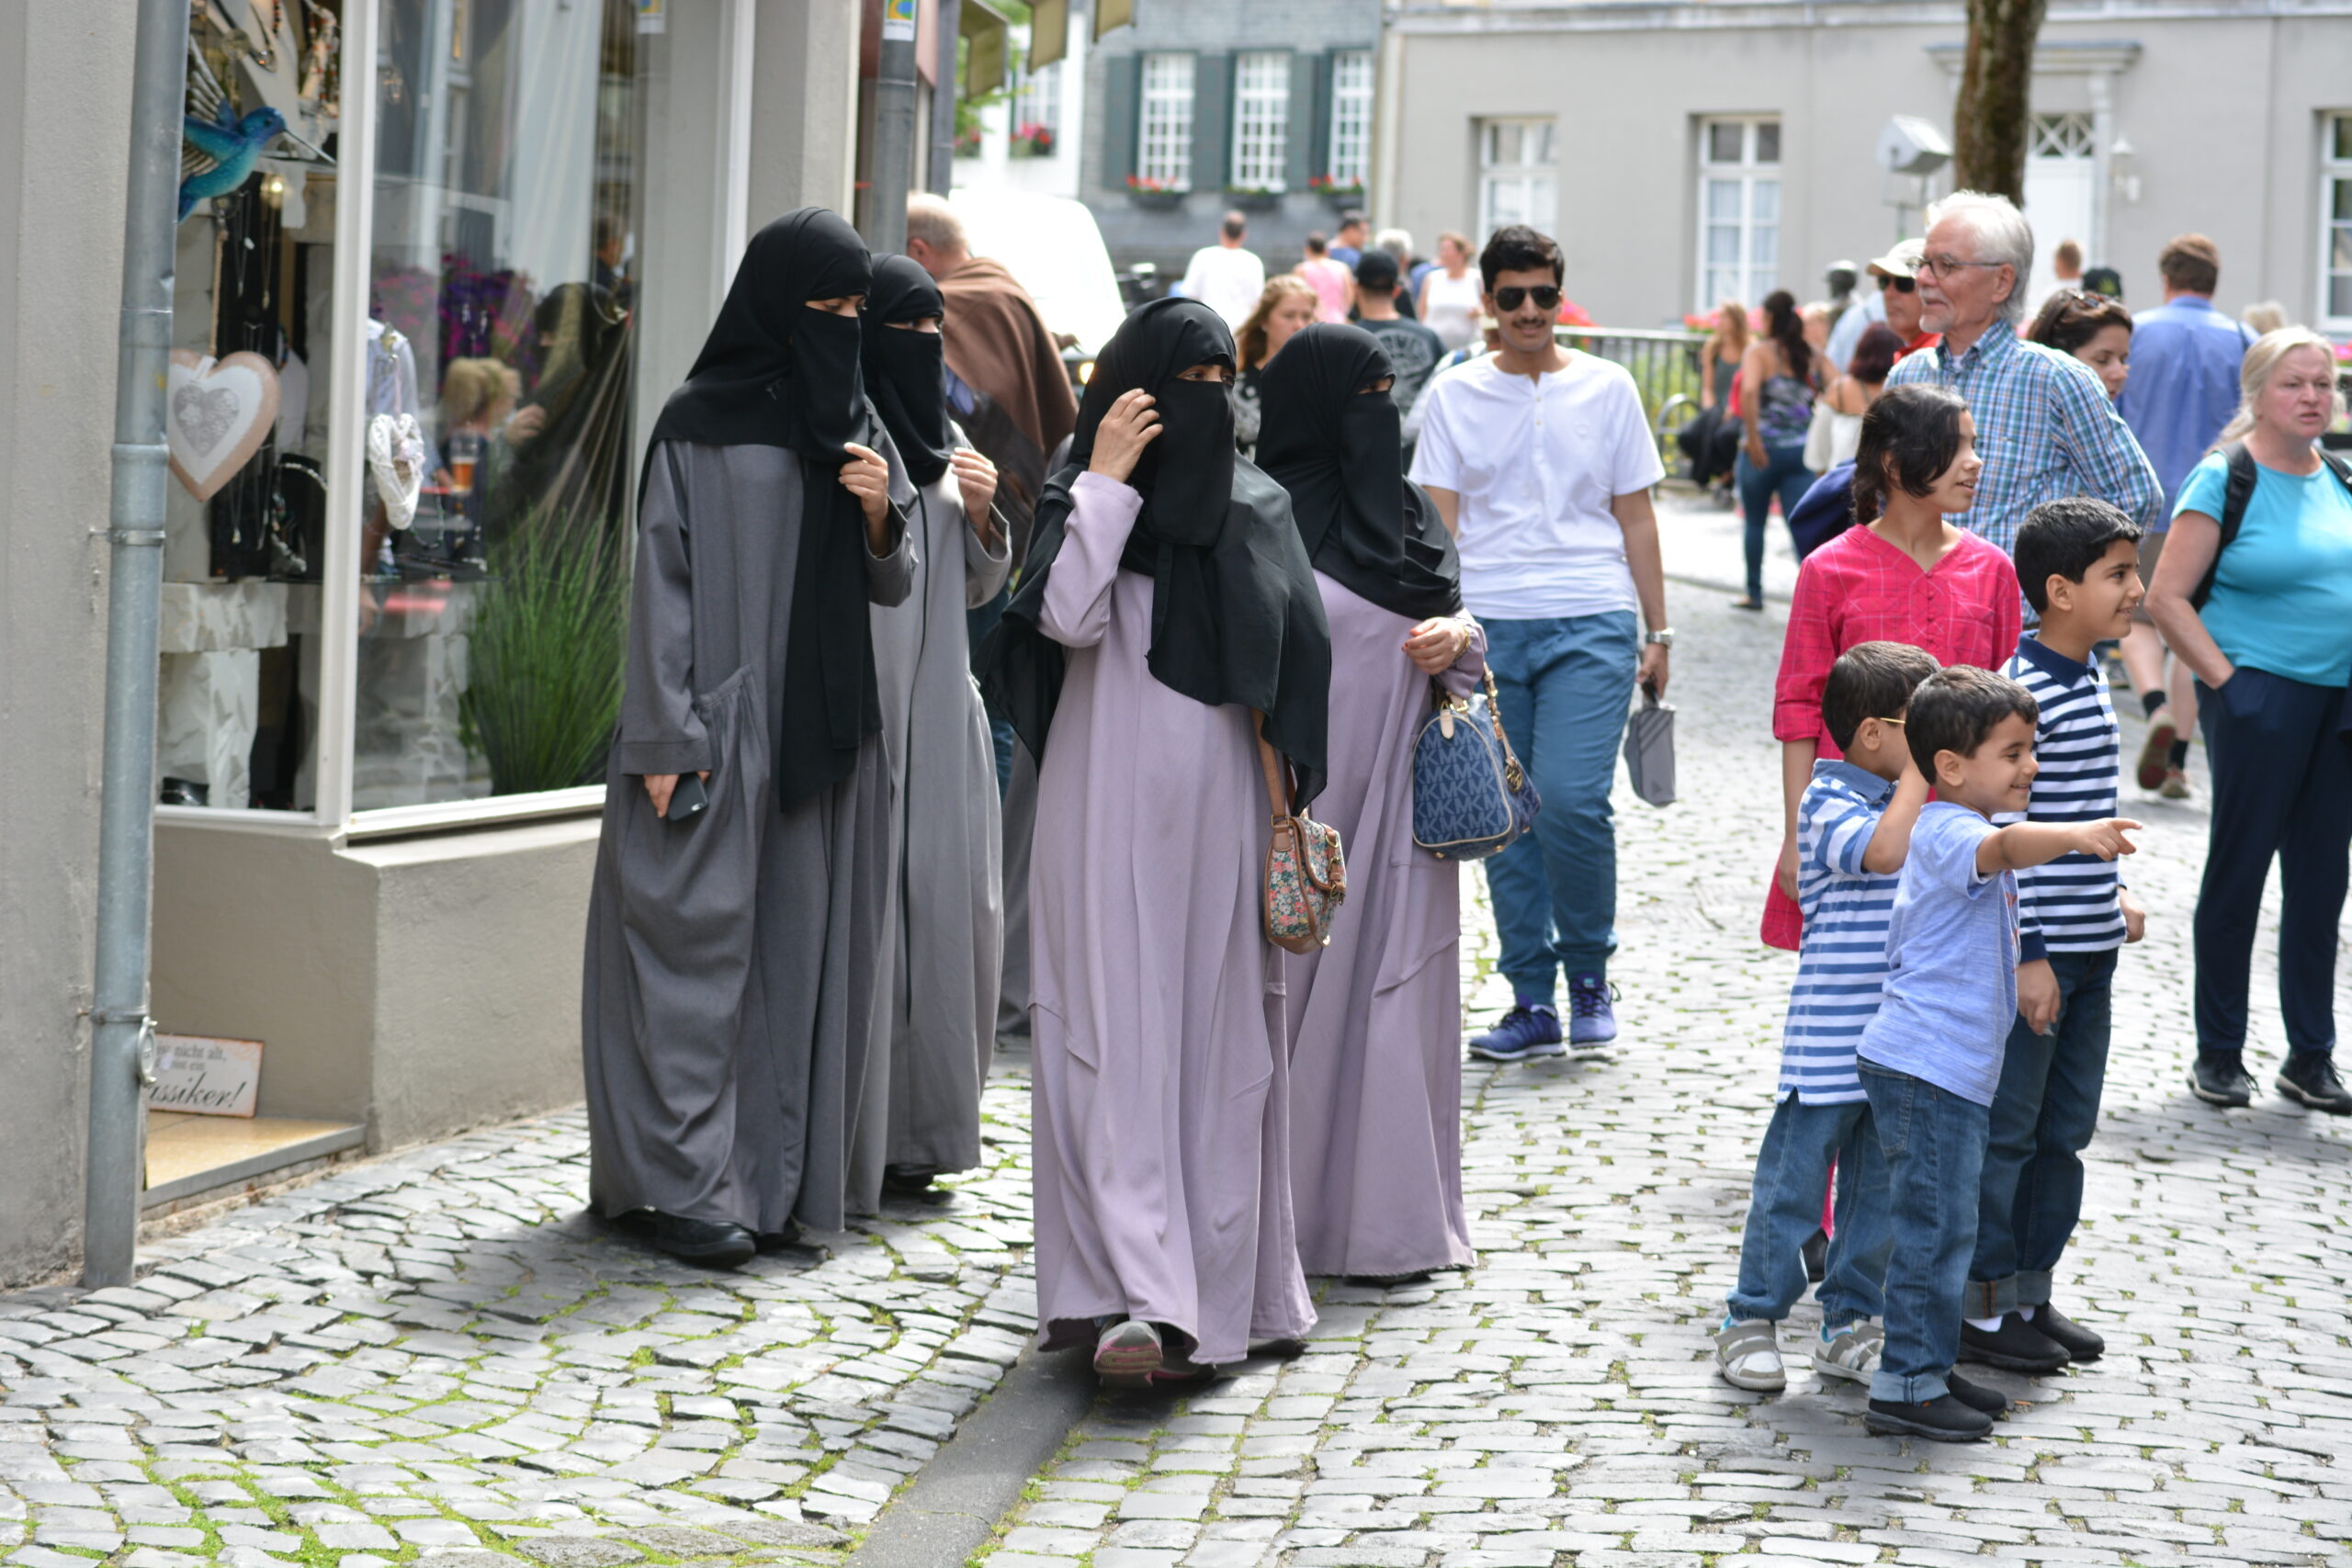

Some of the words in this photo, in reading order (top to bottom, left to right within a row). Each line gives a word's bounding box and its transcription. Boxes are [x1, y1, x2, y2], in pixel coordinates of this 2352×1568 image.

[1439, 745, 1468, 765] MK
[1425, 763, 1454, 784] MK
[1453, 761, 1484, 781] MK
[1440, 780, 1469, 800] MK
[1468, 776, 1498, 796] MK
[1426, 796, 1455, 818] MK
[1454, 794, 1485, 815] MK
[1440, 813, 1469, 834] MK
[1468, 809, 1498, 830] MK
